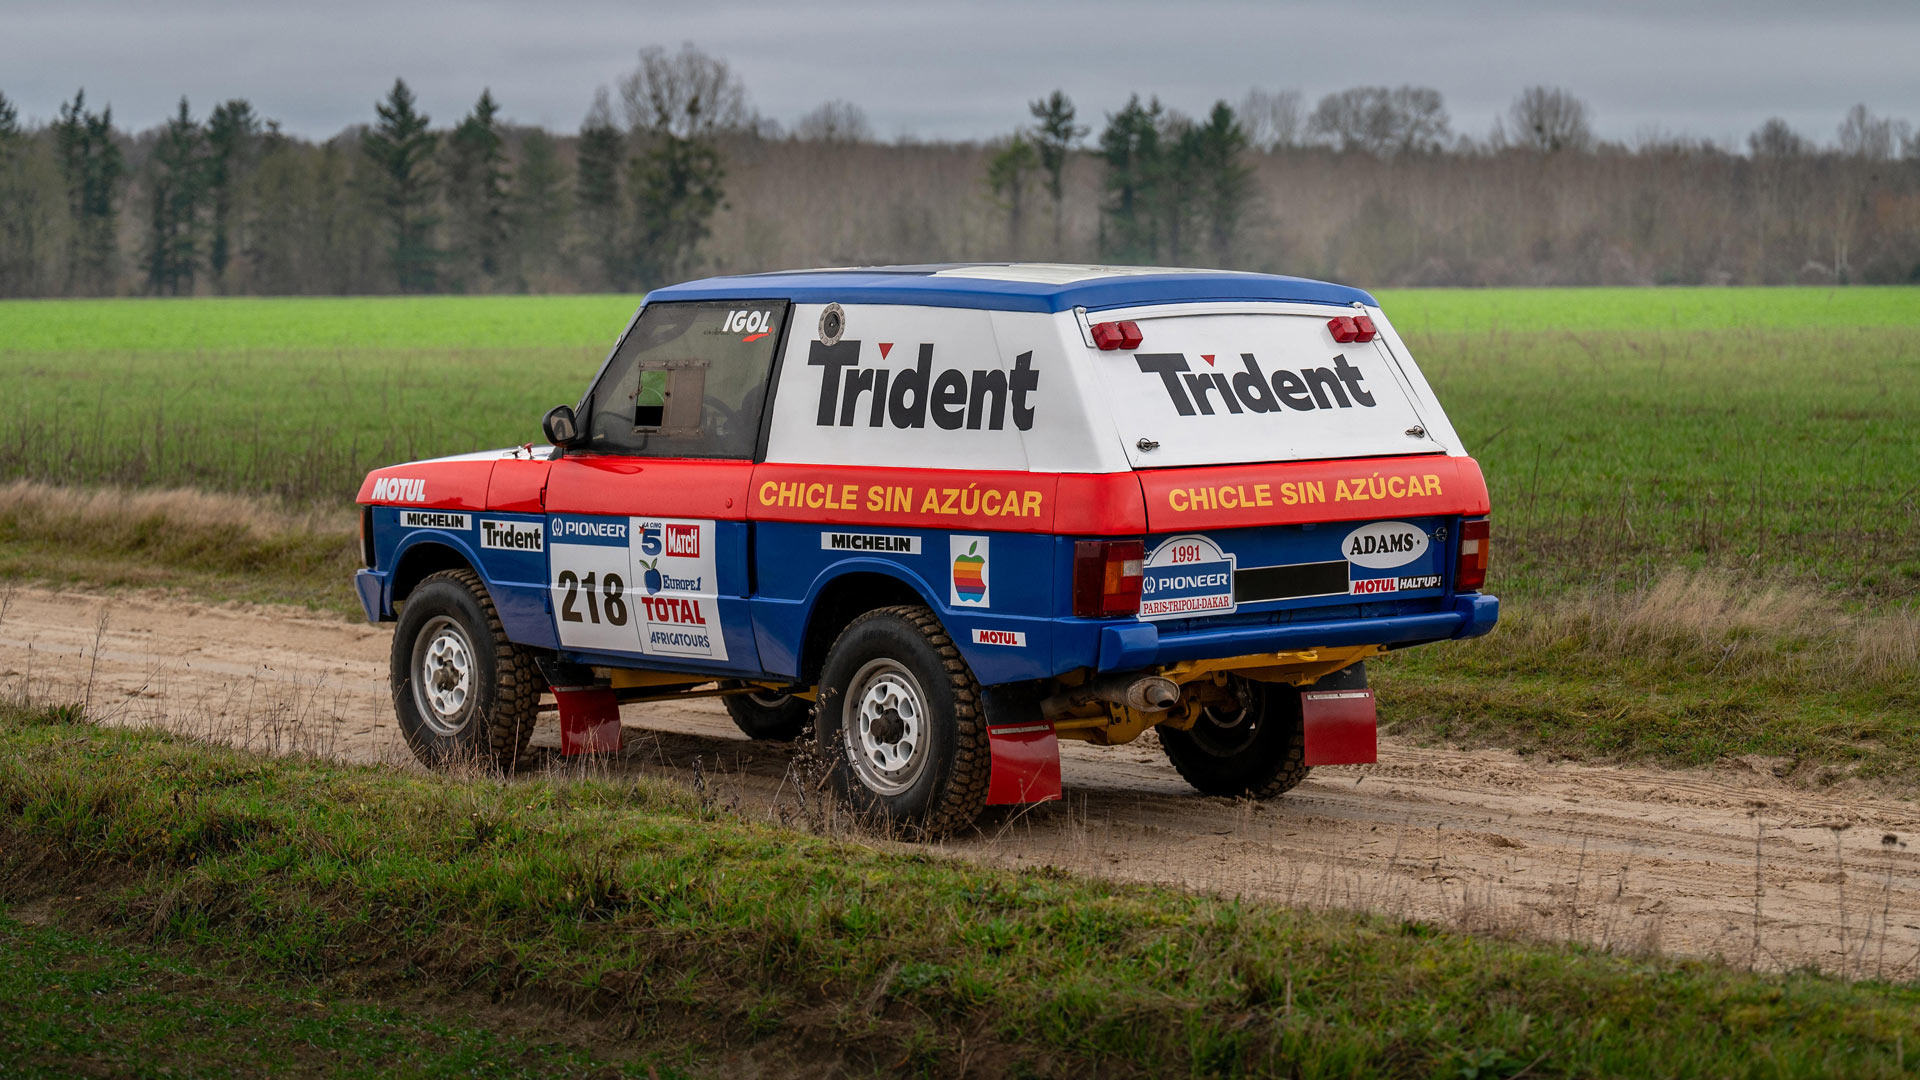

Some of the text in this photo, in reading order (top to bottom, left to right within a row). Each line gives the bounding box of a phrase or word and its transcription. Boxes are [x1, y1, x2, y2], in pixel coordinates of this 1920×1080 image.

[722, 310, 771, 333] IGOL
[807, 339, 1040, 431] Trident
[1133, 352, 1377, 417] Trident
[371, 477, 426, 502] MOTUL
[759, 481, 1043, 517] CHICLE SIN AZÚCAR
[1168, 471, 1442, 512] CHICLE SIN AZÚCAR
[406, 512, 464, 528] MICHELIN
[565, 521, 627, 538] PIONEER
[482, 520, 541, 550] Trident
[641, 529, 662, 556] 5
[668, 527, 697, 554] MATCH
[831, 533, 911, 552] MICHELIN
[1171, 545, 1201, 563] 1991
[1159, 573, 1228, 590] PIONEER
[1353, 578, 1396, 594] MOTUL
[557, 569, 628, 627] 218
[641, 596, 706, 624] TOTAL
[651, 631, 710, 648] AFRICATOURS
[979, 631, 1018, 645] MOTUL
